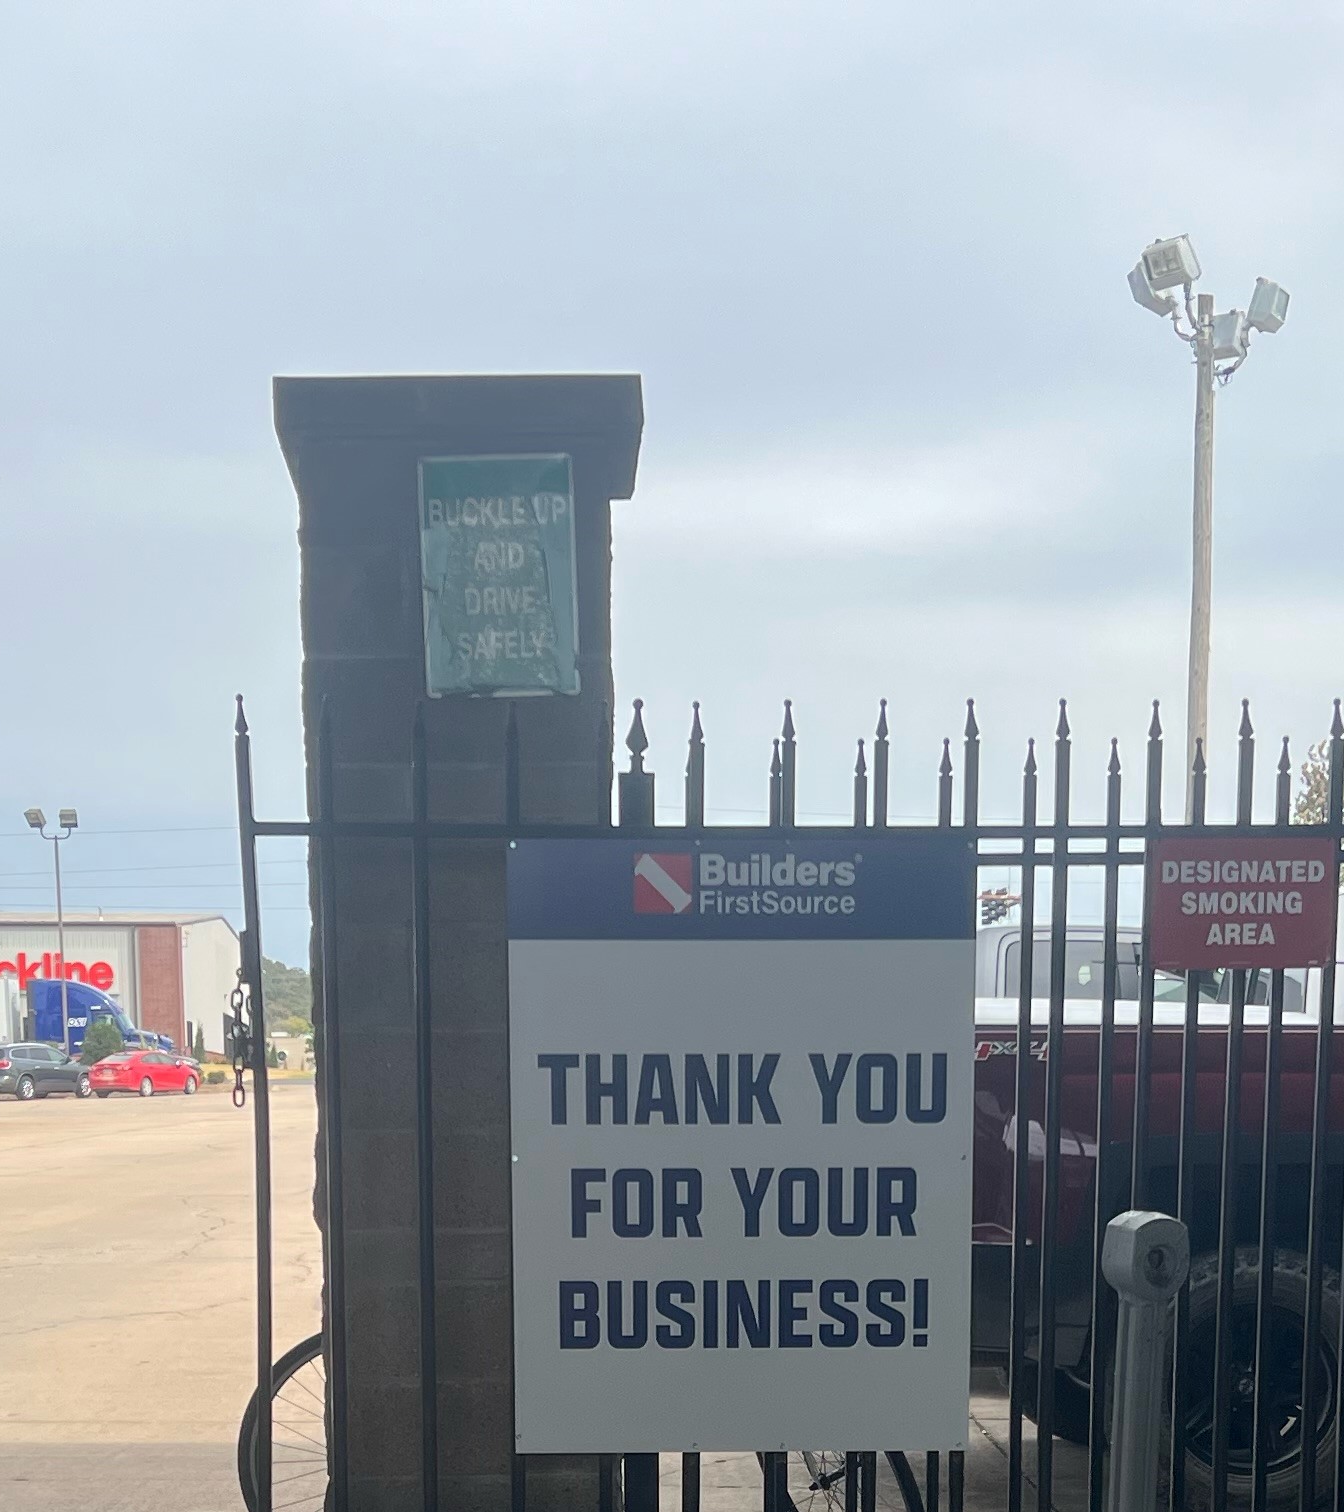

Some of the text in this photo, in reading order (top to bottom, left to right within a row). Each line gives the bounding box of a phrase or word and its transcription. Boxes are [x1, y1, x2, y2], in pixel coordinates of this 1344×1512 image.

[429, 496, 566, 527] BUCKLE UP
[474, 541, 526, 572] AND
[464, 585, 537, 617] DRIVE
[457, 627, 548, 661] SAFELY
[699, 853, 856, 887] Builders
[1161, 860, 1325, 884] DESIGNATED
[699, 890, 856, 915] FirstSource
[1181, 891, 1303, 915] SMOKING
[1206, 923, 1276, 946] AREA
[537, 1053, 948, 1126] THANK YOU
[570, 1167, 917, 1239] FOR YOUR
[559, 1278, 929, 1350] BUSINESS!
